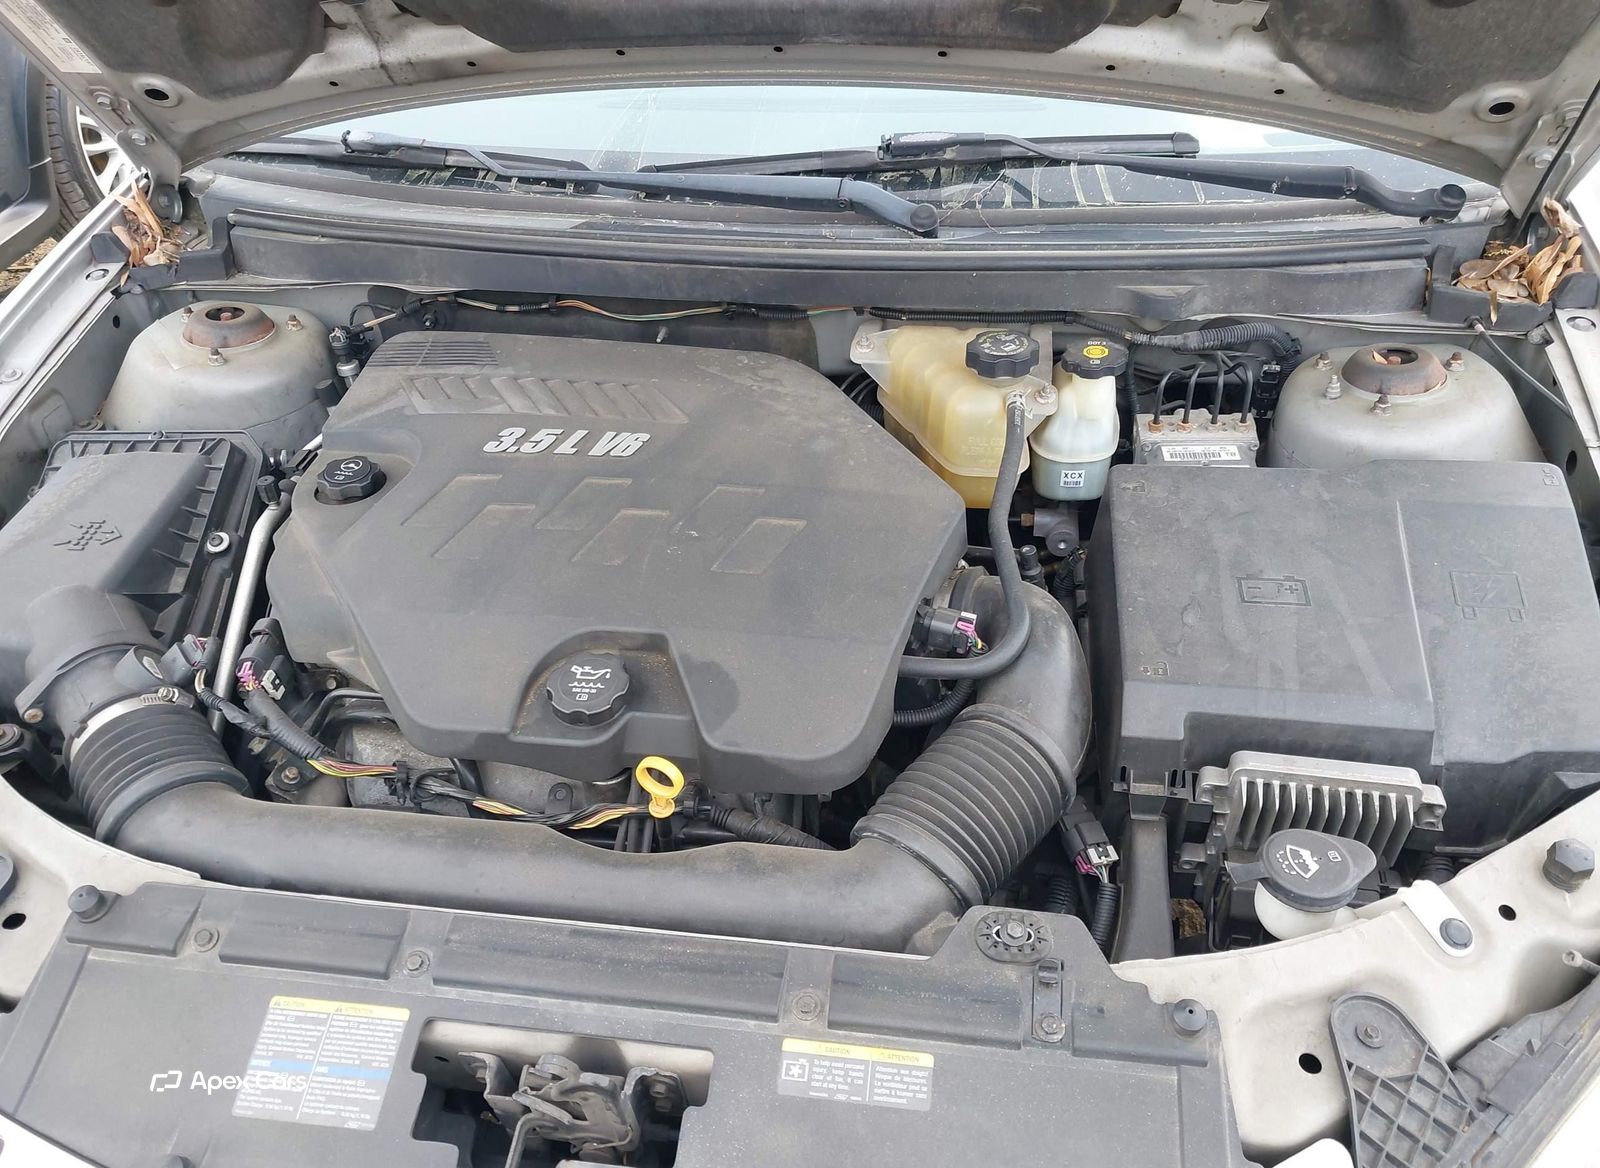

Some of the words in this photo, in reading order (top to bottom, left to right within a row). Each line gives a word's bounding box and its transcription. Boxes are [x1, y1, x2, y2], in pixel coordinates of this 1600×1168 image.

[483, 427, 565, 453] 3.5
[553, 430, 589, 455] L
[588, 431, 651, 457] V6
[824, 1046, 850, 1055] CAUTION
[886, 1053, 919, 1063] ATTENTION
